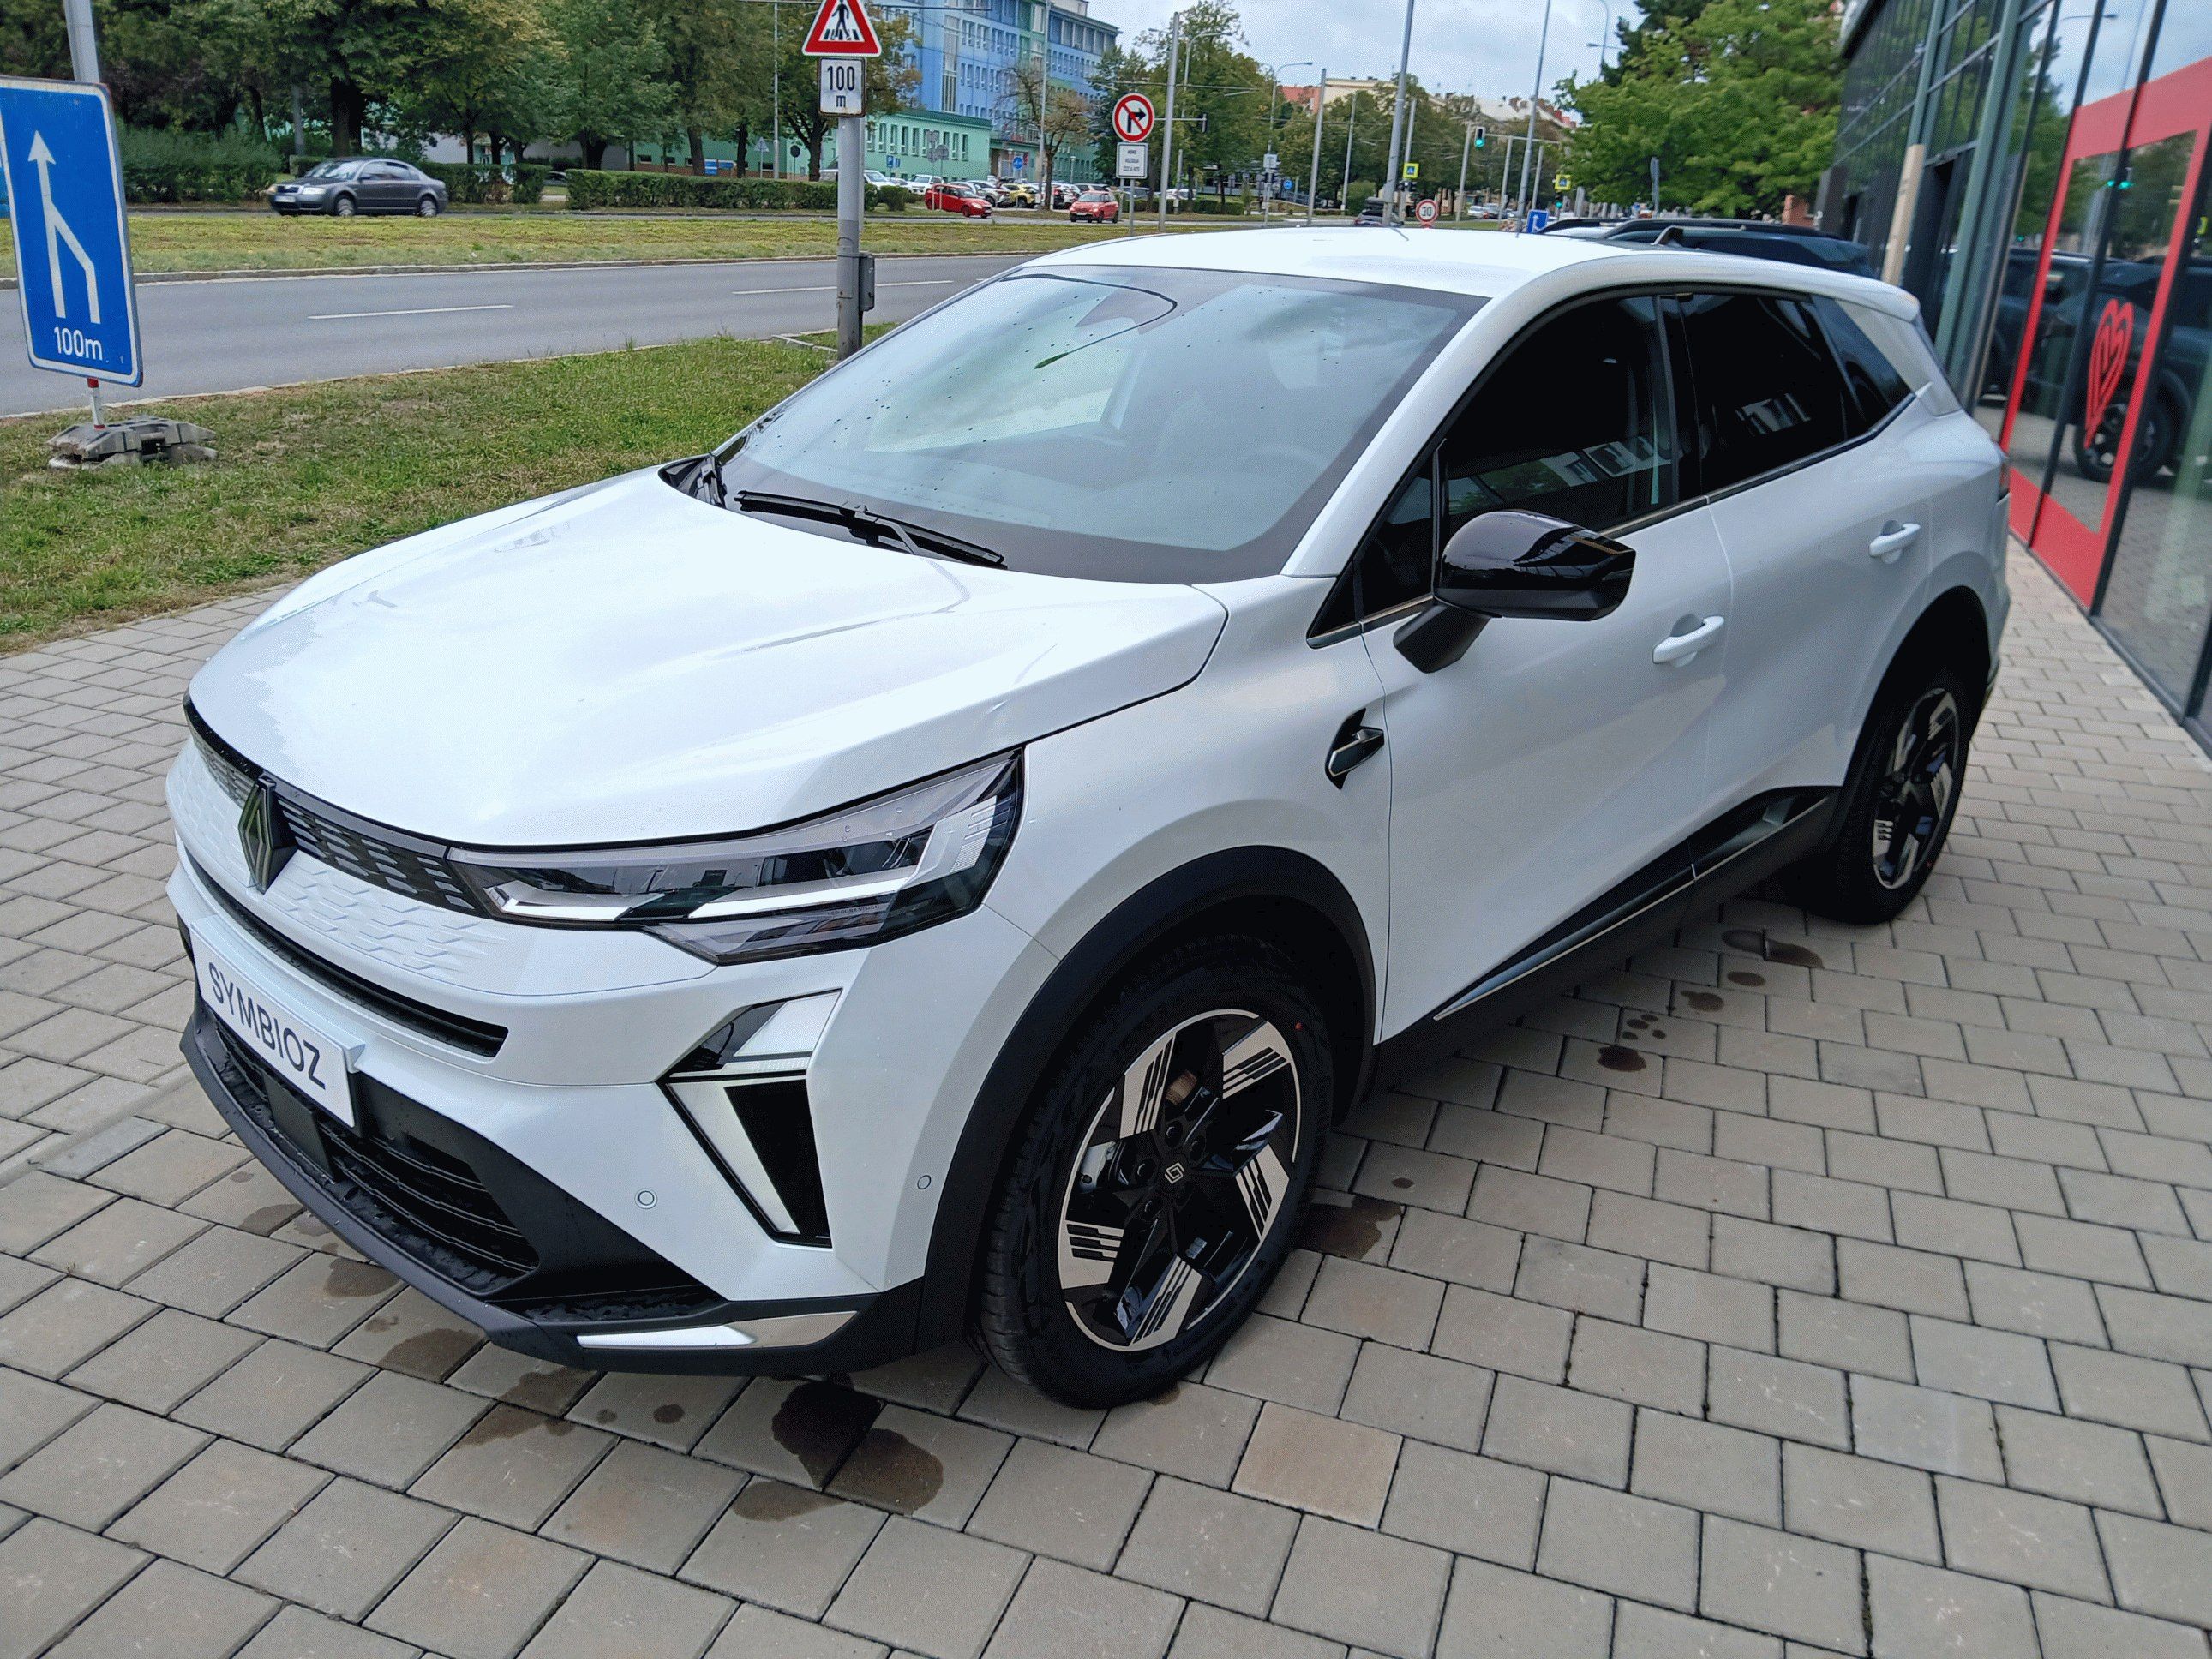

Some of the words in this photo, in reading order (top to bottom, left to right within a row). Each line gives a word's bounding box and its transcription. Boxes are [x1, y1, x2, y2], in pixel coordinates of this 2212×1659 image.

[827, 65, 855, 91] 100
[836, 95, 847, 108] m
[1422, 206, 1433, 217] 30
[53, 326, 103, 361] 100m
[208, 961, 326, 1091] SYMBIOZ
